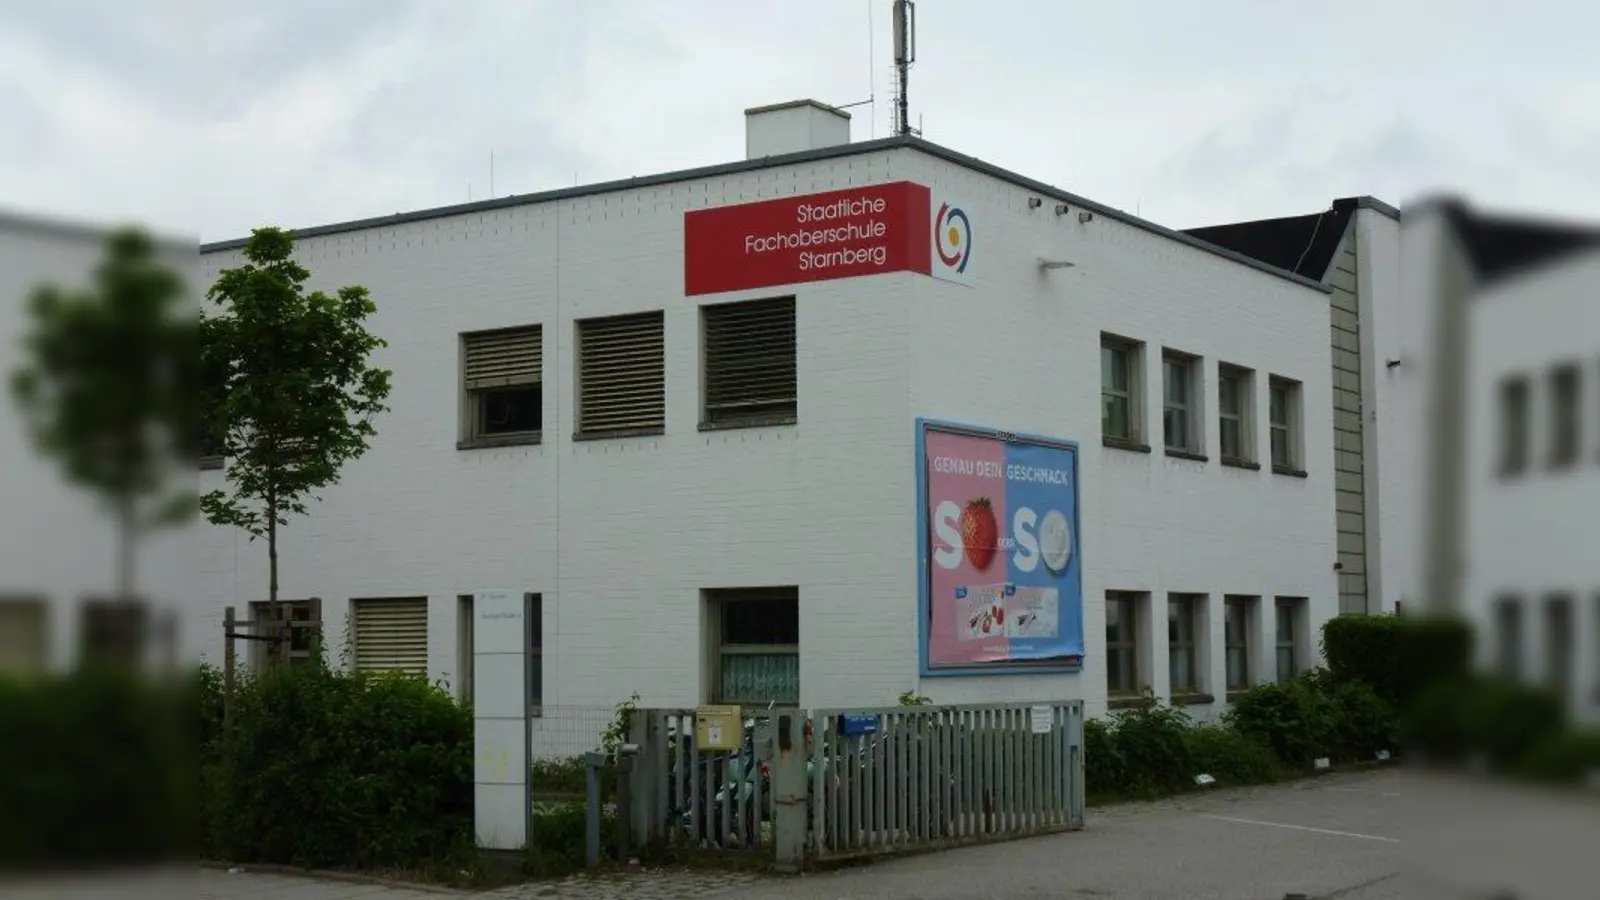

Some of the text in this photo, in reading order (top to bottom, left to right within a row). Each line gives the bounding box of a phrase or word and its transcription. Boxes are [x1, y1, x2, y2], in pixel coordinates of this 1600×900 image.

[797, 197, 885, 222] Staatliche
[745, 220, 886, 253] Fachoberschule
[799, 245, 886, 270] Starnberg
[934, 456, 1068, 485] GENAU DEIN GESCHMACK
